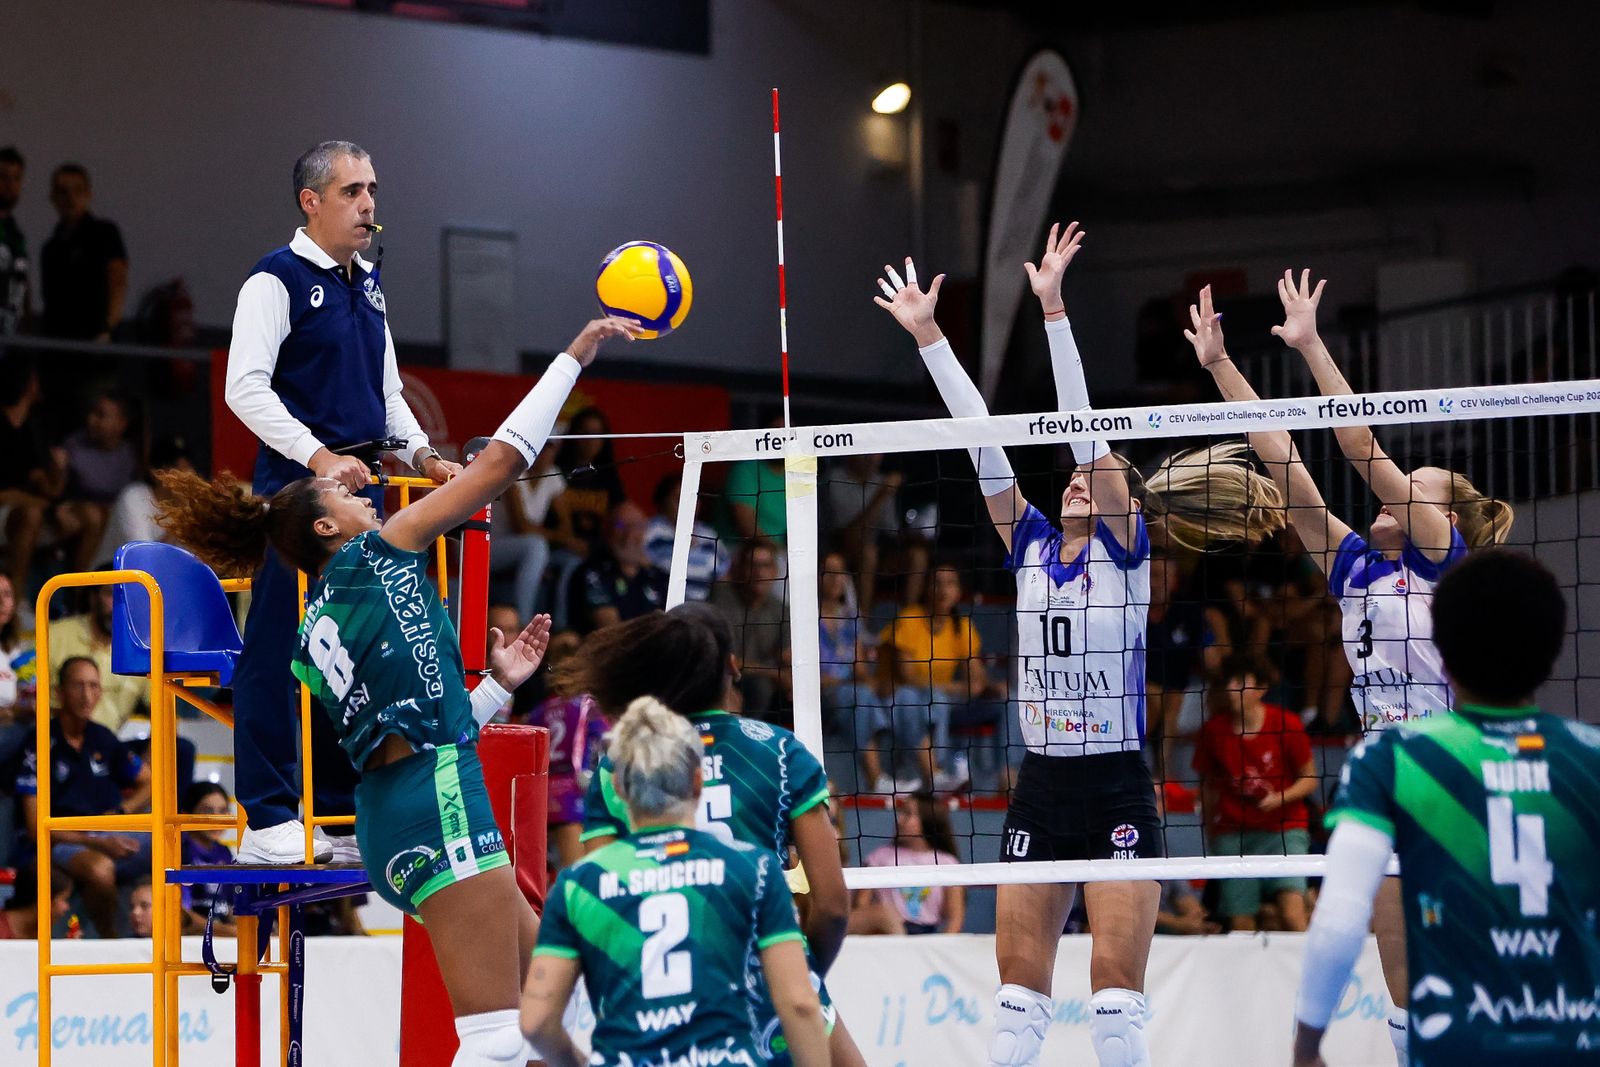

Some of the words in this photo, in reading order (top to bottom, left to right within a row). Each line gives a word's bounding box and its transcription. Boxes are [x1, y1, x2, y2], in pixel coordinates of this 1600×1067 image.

[1169, 414, 1185, 424] CEV
[1186, 412, 1226, 424] Volleyball
[1226, 410, 1267, 421] Challenge
[1268, 409, 1286, 419] Cup
[1287, 408, 1307, 417] 2024
[1318, 396, 1427, 419] rfevb.com
[1460, 399, 1478, 408] CEV
[1479, 396, 1520, 408] Volleyball
[1522, 394, 1565, 405] Challenge
[1566, 393, 1585, 403] Cup
[1586, 391, 1600, 400] 202
[1029, 414, 1132, 436] rfevb.com
[1040, 614, 1071, 657] 10
[1357, 619, 1374, 659] 3
[309, 615, 355, 703] 8
[1486, 796, 1553, 917] 4
[599, 871, 627, 900] M.
[628, 858, 725, 896] SAUCEDO
[639, 892, 692, 1000] 2
[1490, 928, 1560, 956] WAY
[635, 1001, 697, 1032] WAY
